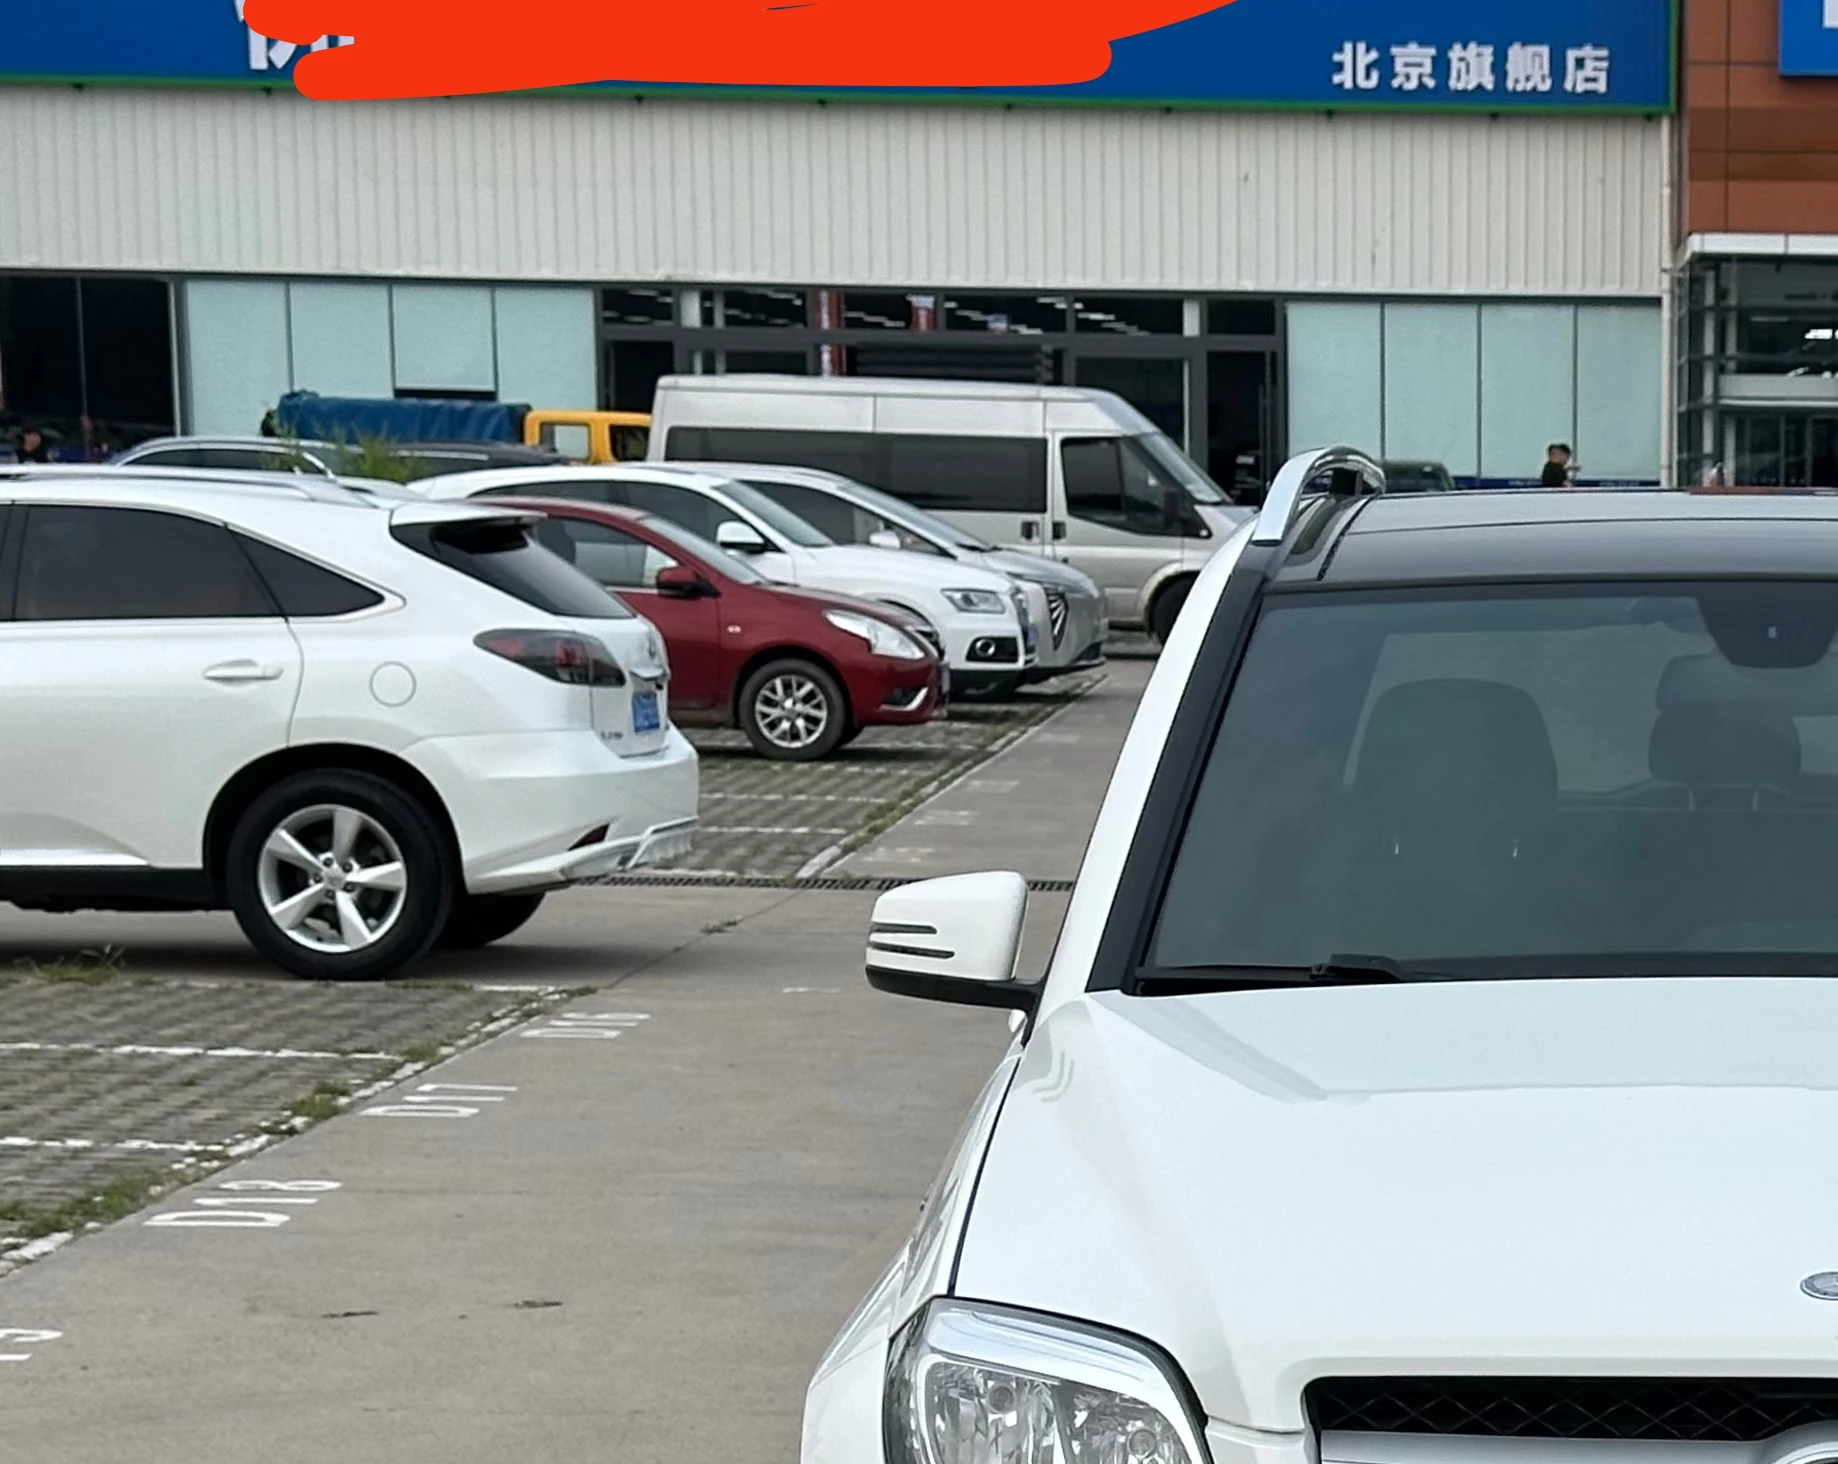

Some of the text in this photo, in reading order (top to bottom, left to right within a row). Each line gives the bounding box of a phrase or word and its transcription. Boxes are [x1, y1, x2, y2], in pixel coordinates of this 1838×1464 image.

[1332, 41, 1609, 93] 北京旗舰店
[359, 1083, 518, 1117] D17
[142, 1179, 343, 1226] D18
